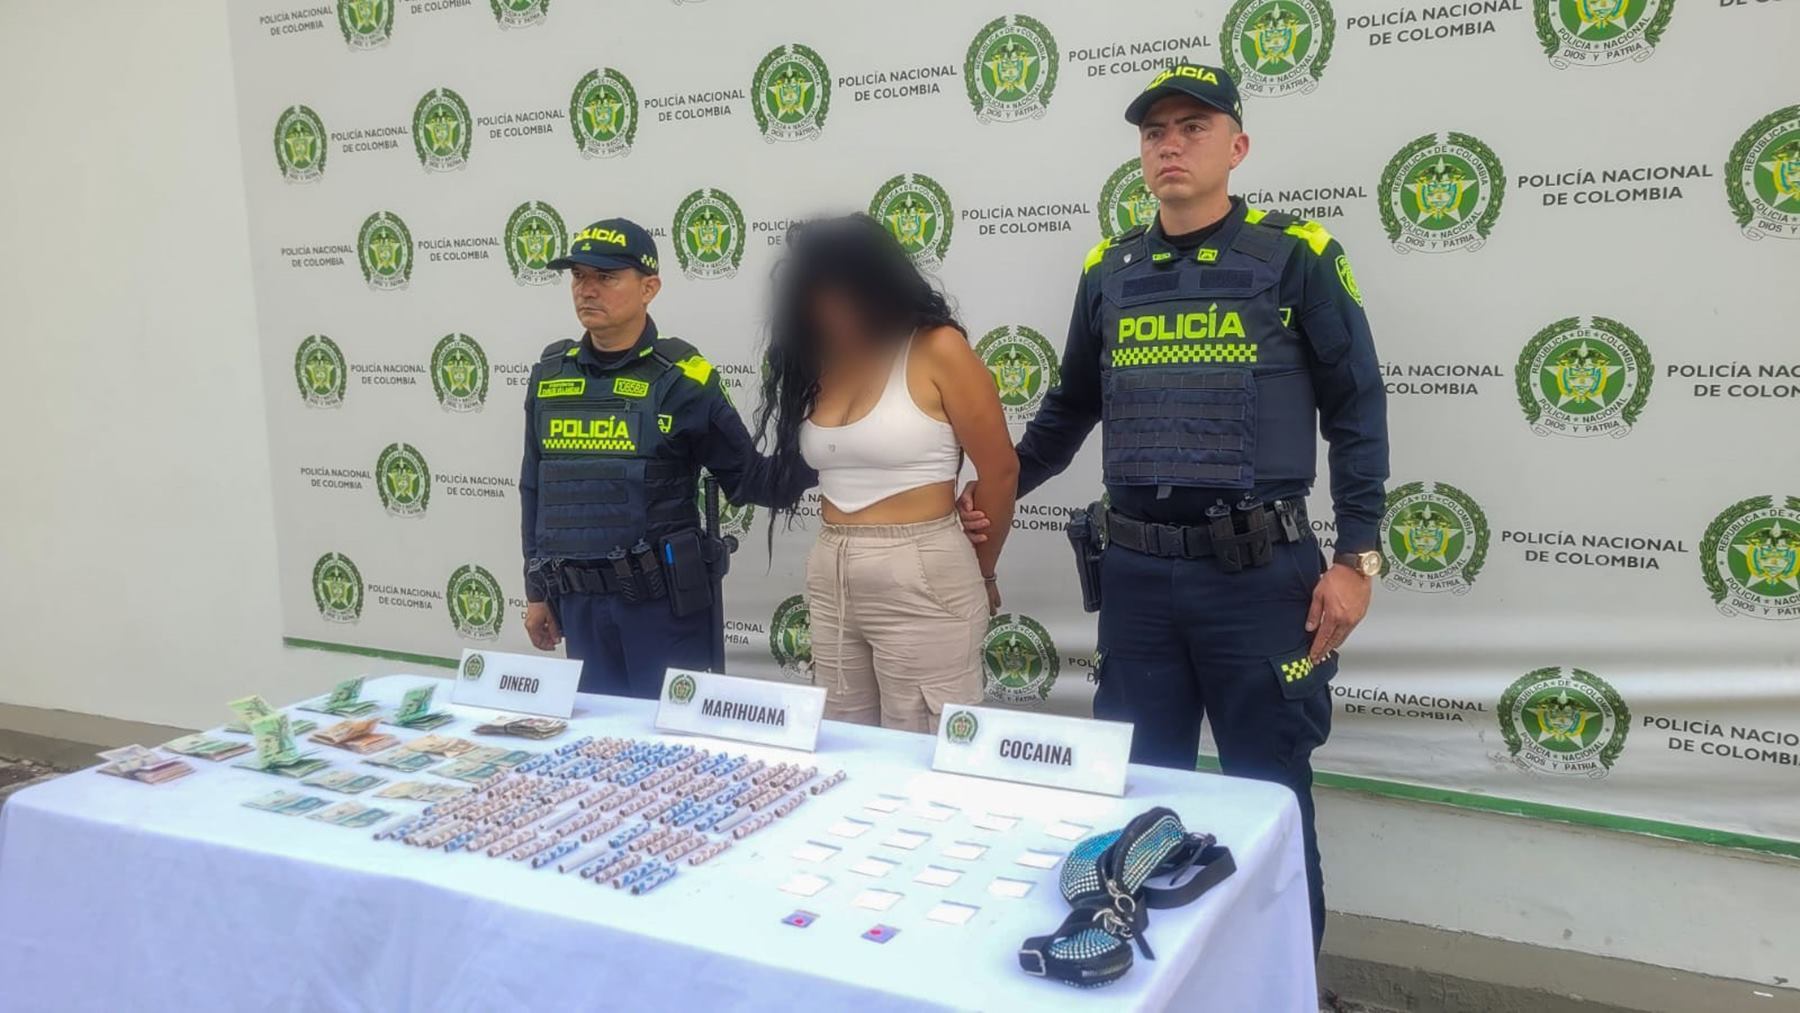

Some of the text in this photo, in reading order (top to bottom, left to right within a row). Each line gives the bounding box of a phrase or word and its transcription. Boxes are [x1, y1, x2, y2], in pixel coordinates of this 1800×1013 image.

[291, 6, 333, 20] NACIONAL
[411, 4, 422, 14] DE
[1346, 0, 1522, 30] POLICÍA NACIONAL
[270, 20, 324, 36] DE COLOMBIA
[1369, 20, 1496, 46] DE COLOMBIA
[1558, 17, 1650, 49] POLICIA NACIONAL
[1069, 35, 1211, 63] POLICÍA NACIONAL
[1564, 49, 1585, 60] DIOS
[1607, 43, 1642, 59] PATRIA
[838, 65, 958, 88] POLICÍA NACIONAL
[1087, 64, 1106, 77] DE
[644, 89, 745, 109] POLICÍA NACIONAL
[854, 82, 940, 102] DE COLOMBIA
[515, 109, 565, 123] NACIONAL
[658, 105, 732, 122] DE COLOMBIA
[364, 126, 408, 138] NACIONAL
[489, 123, 553, 139] DE COLOMBIA
[342, 139, 398, 153] DE COLOMBIA
[1745, 126, 1787, 171] REPUBLICA
[1518, 164, 1713, 188] POLICÍA NACIONAL
[1278, 186, 1367, 202] NACIONAL
[1542, 186, 1683, 206] DE COLOMBIA
[961, 203, 1091, 221] POLICÍA NACIONAL
[1752, 198, 1788, 222] POLICIA
[979, 220, 1072, 235] DE COLOMBIA
[1759, 221, 1782, 232] DIOS
[453, 237, 500, 248] NACIONAL
[767, 235, 781, 246] DE
[430, 250, 489, 262] DE COLOMBIA
[1118, 303, 1247, 344] POLICÍA
[1532, 335, 1568, 374] REPUBLICA
[1601, 333, 1635, 372] COLOMBIA
[383, 364, 426, 373] NACIONAL
[1408, 365, 1504, 377] NACIONAL
[1667, 361, 1752, 378] POLICÍA
[361, 376, 416, 385] DE COLOMBIA
[506, 377, 518, 386] DE
[1385, 382, 1478, 394] COLOMBIA
[1694, 384, 1721, 397] DE
[1539, 397, 1627, 423] POLICIA NACIONAL
[550, 415, 629, 438] POLICÍA
[1545, 419, 1565, 430] DIOS
[1586, 421, 1619, 432] PATRIA
[331, 469, 372, 479] NACIONAL
[469, 476, 515, 487] NACIONAL
[311, 479, 362, 489] DE COLOMBIA
[447, 486, 505, 498] DE COLOMBIA
[1719, 513, 1760, 552] REPUBLICA
[1501, 530, 1689, 553] POLICÍA NACIONAL
[1525, 550, 1660, 570] DE COLOMBIA
[400, 587, 443, 599] NACIONAL
[1726, 578, 1760, 602] POLICIA
[378, 596, 432, 609] DE COLOMBIA
[1732, 599, 1755, 611] DIOS
[499, 674, 540, 694] DINERO
[1394, 693, 1488, 714] NACIONAL
[702, 699, 786, 726] MARIHUANA
[1345, 703, 1466, 722] DE COLOMBIA
[1643, 716, 1799, 746] POLICÍA NACIO
[1000, 738, 1072, 766] COCAINA
[1668, 737, 1800, 766] DE COLOMBI
